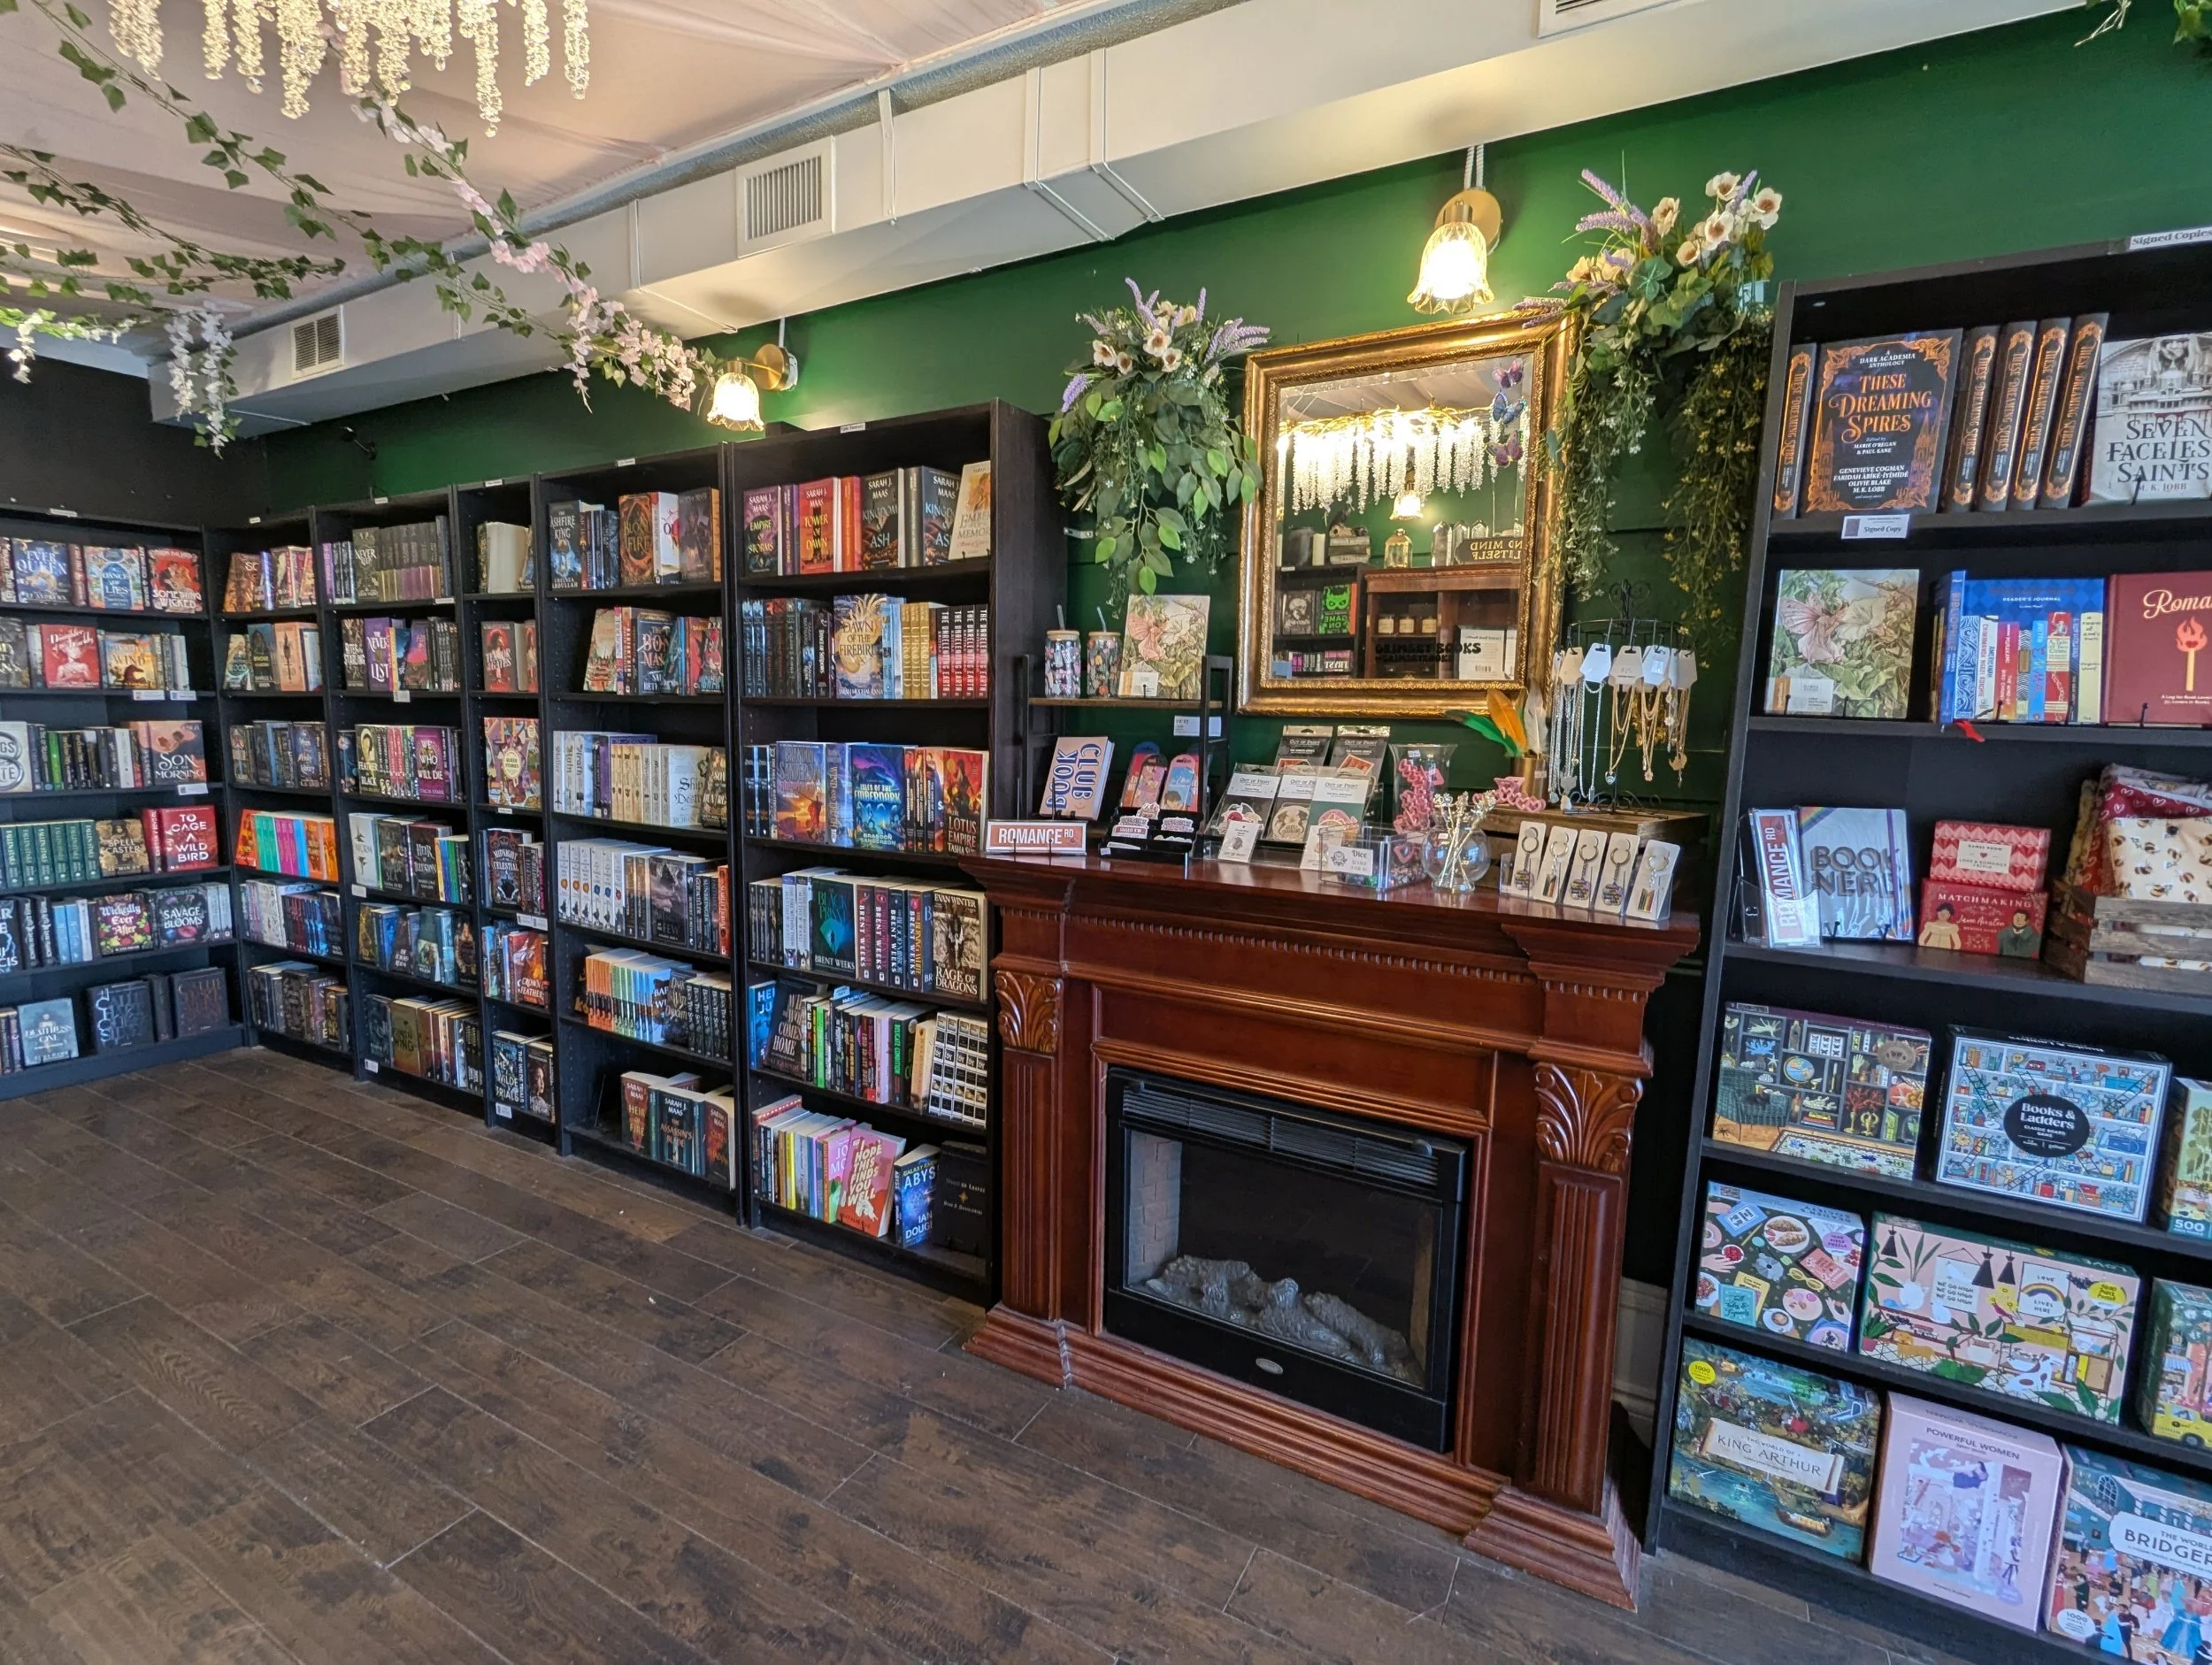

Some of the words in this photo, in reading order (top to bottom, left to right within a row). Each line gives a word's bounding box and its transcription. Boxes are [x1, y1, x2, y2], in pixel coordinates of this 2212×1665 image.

[2131, 233, 2172, 247] Signed
[1859, 356, 1878, 364] DARK
[1879, 353, 1916, 363] ACADEMIA
[1859, 373, 1907, 394] THESE
[1829, 390, 1932, 418] DREAMING
[1841, 414, 1912, 444] SPIRES
[2126, 418, 2212, 440] SEVEN
[2116, 462, 2209, 484] SAINTS
[868, 479, 887, 490] SARAH
[933, 476, 955, 487] SARAH
[749, 495, 767, 505] SARAH
[806, 488, 821, 499] SARAH
[872, 491, 888, 500] MAAS
[938, 488, 956, 500] MAAS
[752, 503, 769, 512] MAAS
[810, 498, 824, 509] MAAS
[863, 503, 898, 520] KINGDOM
[549, 515, 576, 529] ASHFIRE
[749, 519, 772, 531] EMPIRE
[804, 514, 829, 528] TOWER
[554, 527, 572, 540] KING
[806, 538, 828, 549] DAWN
[870, 533, 890, 549] ASH
[748, 542, 774, 555] STORMS
[16, 560, 68, 576] QUEEN
[158, 597, 197, 609] WICKED
[842, 620, 873, 633] DAWN
[847, 634, 857, 643] OF
[857, 634, 871, 643] THE
[371, 664, 390, 682] LIST
[420, 739, 433, 750] WE
[158, 752, 198, 770] SON
[419, 754, 438, 765] WHO
[155, 768, 204, 780] MORNING
[417, 770, 432, 780] WILL
[432, 770, 443, 780] DIE
[1045, 749, 1079, 809] BOOK
[1072, 743, 1102, 801] CLUB
[361, 775, 378, 786] BLACK
[179, 813, 198, 823] TO
[949, 816, 977, 831] LOTUS
[171, 821, 207, 832] CAGE
[107, 839, 136, 848] SPELL
[186, 832, 197, 842] A
[948, 832, 977, 848] EMPIRE
[997, 827, 1063, 846] ROMANCE
[106, 846, 141, 855] CASTER
[176, 843, 208, 854] WILD
[416, 842, 434, 857] HEIR
[493, 848, 518, 861] MIDNIGHT
[947, 842, 964, 854] TASHA
[1351, 849, 1367, 858] Dice
[177, 851, 210, 863] BIRD
[1809, 845, 1901, 871] BOOK
[1766, 842, 1797, 927] ROMANCE
[933, 894, 951, 902] EVAN
[951, 895, 976, 908] WINTER
[1938, 892, 2032, 909] MATCHMAKING
[99, 903, 142, 917] Wickedly
[163, 906, 202, 921] SAVAGE
[111, 915, 134, 926] Ever
[164, 916, 204, 930] BLOOMS
[111, 925, 138, 937] After
[814, 955, 833, 967] BRENT
[833, 958, 856, 971] WEEKS
[935, 965, 964, 982] RAGE
[936, 978, 978, 995] DRAGONS
[779, 1022, 803, 1040] COMES
[772, 1035, 796, 1055] HOME
[494, 1058, 507, 1070] THE
[496, 1074, 518, 1088] WILDE
[626, 1082, 643, 1093] SARAH
[495, 1088, 519, 1103] TRIALS
[630, 1091, 645, 1100] MAAS
[664, 1097, 682, 1109] SARAH
[629, 1104, 646, 1117] HEIR
[668, 1107, 684, 1116] MAAS
[2021, 1102, 2064, 1117] Books
[2065, 1109, 2076, 1120] &
[2020, 1112, 2075, 1131] Ladders
[629, 1124, 645, 1137] FIRE
[660, 1124, 693, 1139] ASSASSIN'S
[856, 1143, 882, 1161] HOPE
[854, 1158, 875, 1172] THIS
[902, 1165, 925, 1178] GALAXY
[850, 1166, 879, 1185] FINDS
[903, 1165, 940, 1190] ABYS
[849, 1179, 872, 1194] YOU
[848, 1188, 876, 1207] WELL
[918, 1211, 933, 1224] IAN
[2173, 1218, 2205, 1233] 500
[1694, 1364, 1711, 1374] 1000
[1717, 1434, 1753, 1454] KING
[1926, 1427, 1978, 1448] POWERFUL
[1979, 1443, 2021, 1461] WOMEN
[1758, 1449, 1822, 1477] ARTHUR
[2160, 1531, 2178, 1541] THE
[2124, 1529, 2212, 1566] BRIDGER
[2066, 1611, 2088, 1623] 1000
